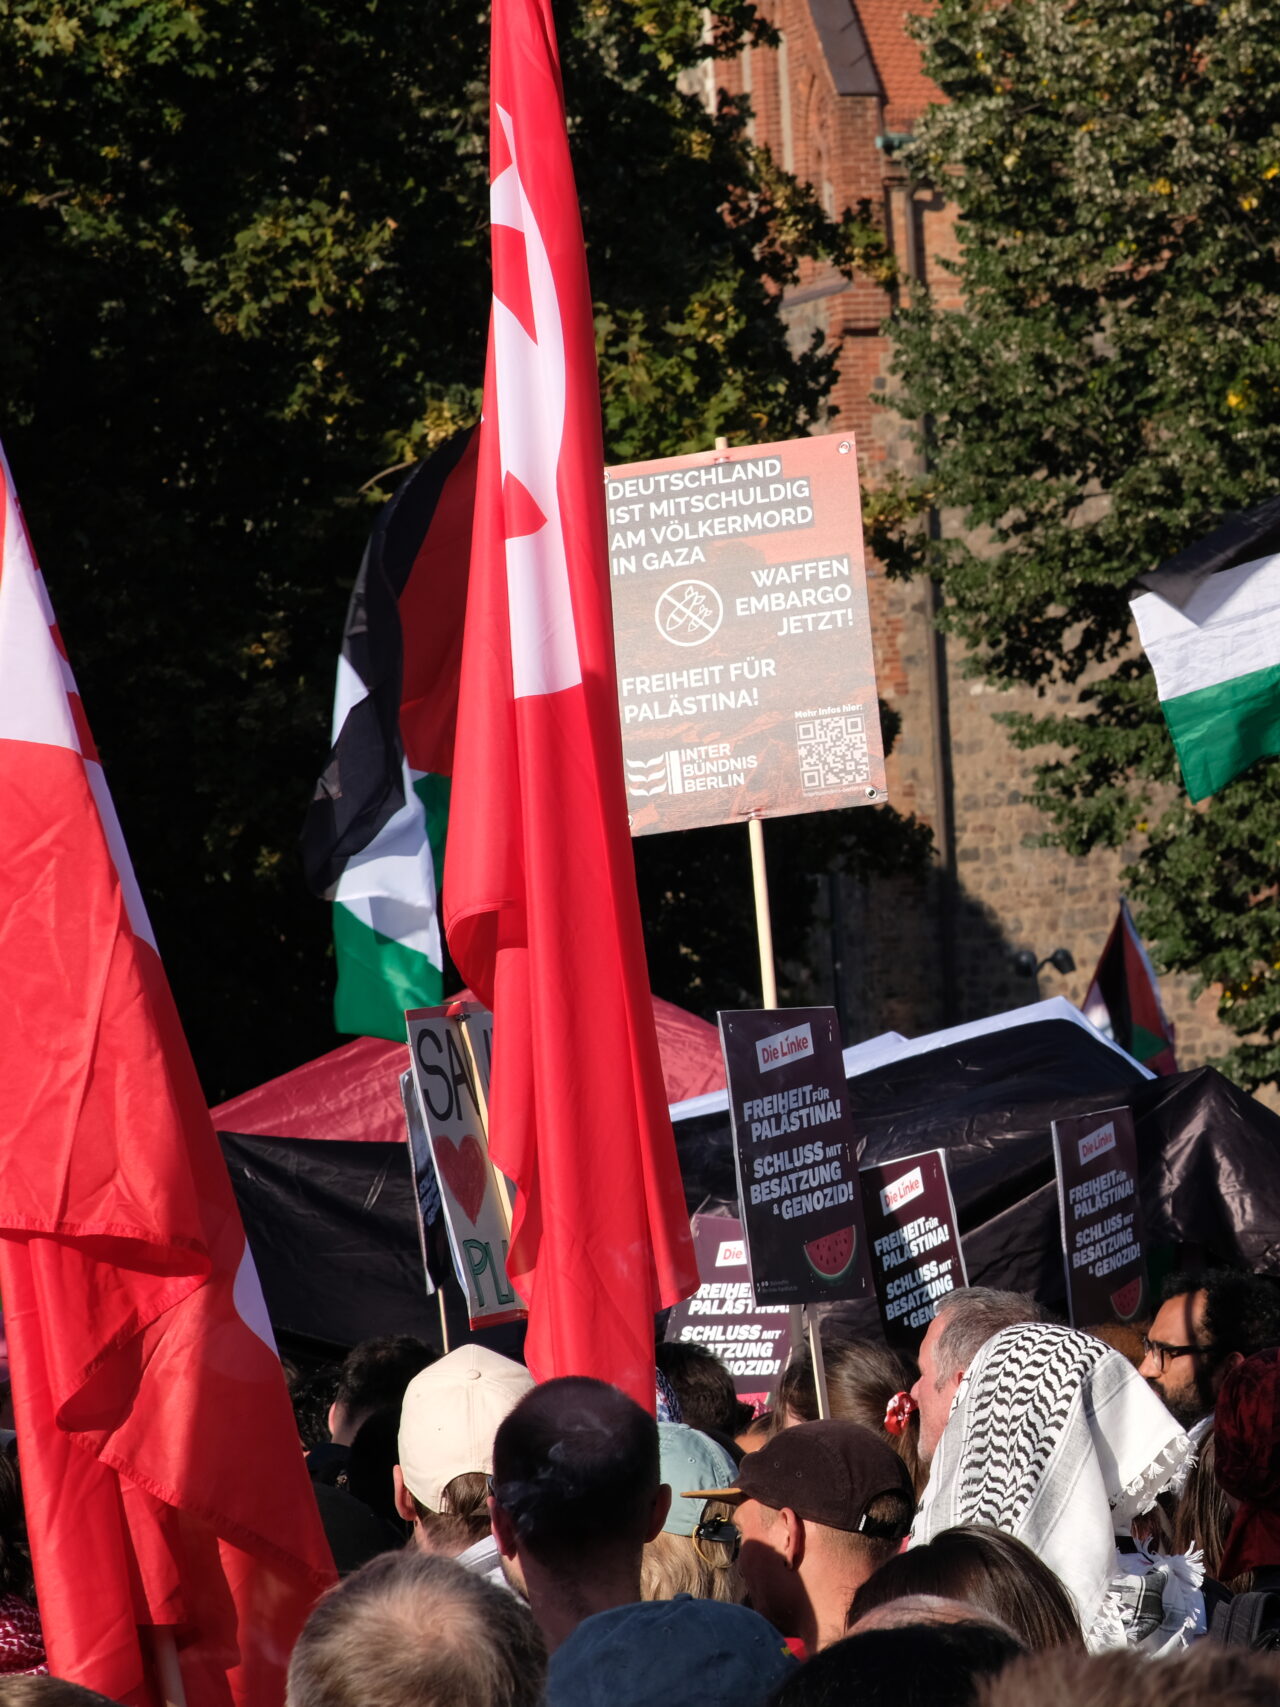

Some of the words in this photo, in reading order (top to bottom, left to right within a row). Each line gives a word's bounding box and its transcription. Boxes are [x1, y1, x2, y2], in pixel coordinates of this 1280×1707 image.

[608, 459, 782, 500] DEUTSCHLAND
[609, 503, 644, 525] IST
[649, 480, 810, 520] MITSCHULDIG
[611, 529, 646, 551] AM
[650, 505, 813, 543] VÖLKERMORD
[612, 555, 637, 576] IN
[642, 546, 706, 571] GAZA
[751, 558, 849, 588] WAFFEN
[735, 583, 852, 616] EMBARGO
[777, 609, 854, 636] JETZT!
[621, 665, 725, 697] FREIHEIT
[729, 656, 777, 682] FÜR
[624, 688, 759, 724] PALÄSTINA!
[795, 710, 817, 719] Mehr
[818, 706, 841, 716] Infos
[681, 743, 731, 761] INTER
[682, 754, 758, 777] BÜNDNIS
[683, 772, 745, 793] BERLIN
[761, 1045, 780, 1065] Die
[780, 1035, 809, 1056] Linke
[743, 1084, 814, 1122] FREIHEIT
[812, 1087, 830, 1103] FÜR
[751, 1099, 842, 1143] PALÄSTINA!
[753, 1141, 824, 1179] SCHLUSS
[825, 1143, 842, 1160] MIT
[750, 1161, 842, 1205] BESATZUNG
[772, 1204, 780, 1215] &
[781, 1181, 854, 1220] GENOZID!
[884, 1191, 897, 1208] Die
[898, 1178, 920, 1200] Linke
[1069, 1169, 1117, 1204] FREIHEIT
[1074, 1178, 1134, 1220] PALÄSTINA!
[874, 1217, 926, 1257] FREIHEIT
[925, 1217, 939, 1231] FÜR
[882, 1224, 950, 1271] PALÄSTINA!
[1072, 1227, 1133, 1269] BESATZUNG
[1075, 1212, 1122, 1248] SCHLUSS
[722, 1248, 743, 1261] Die
[1094, 1242, 1141, 1278] GENOZID!
[885, 1274, 953, 1320] BESATZUNG
[886, 1260, 939, 1300] SCHLUSS
[938, 1259, 952, 1275] MIT
[680, 1324, 762, 1342] SCHLUSS
[761, 1330, 782, 1340] MIT
